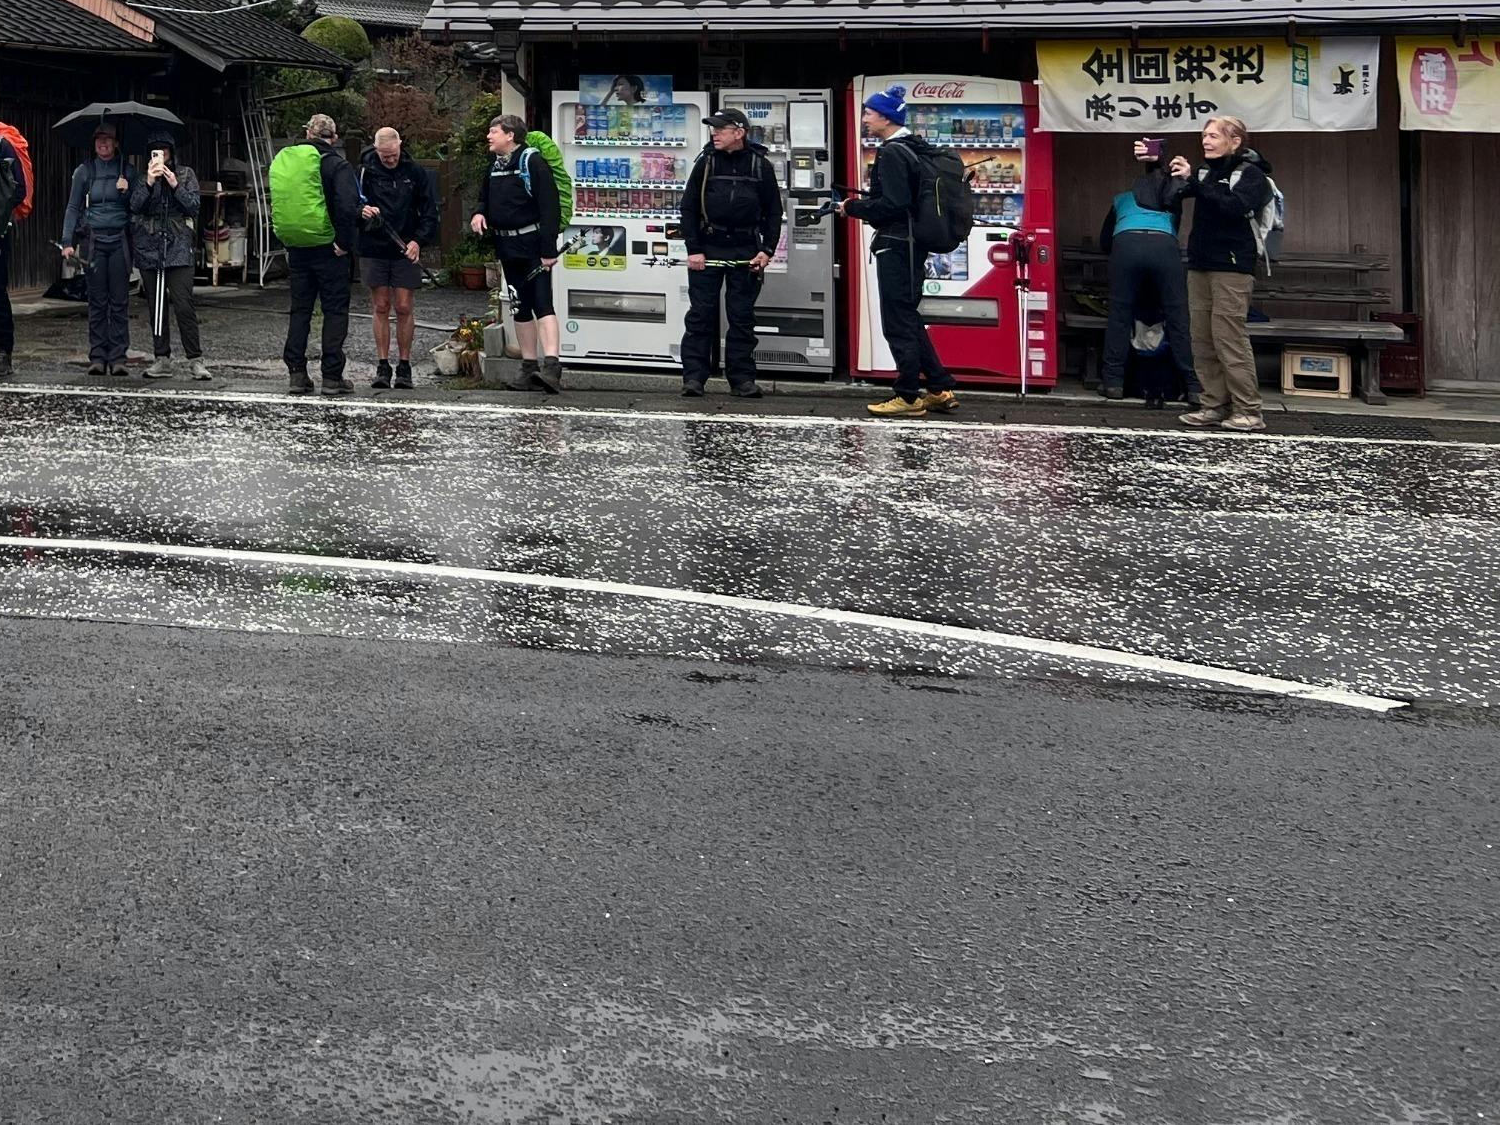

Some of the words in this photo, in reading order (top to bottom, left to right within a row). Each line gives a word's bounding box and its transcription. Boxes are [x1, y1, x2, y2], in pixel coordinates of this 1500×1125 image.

[1082, 43, 1265, 86] 全国発送
[744, 102, 772, 110] LIQUOR
[747, 110, 769, 119] SHOP
[1085, 92, 1219, 122] 承ります
